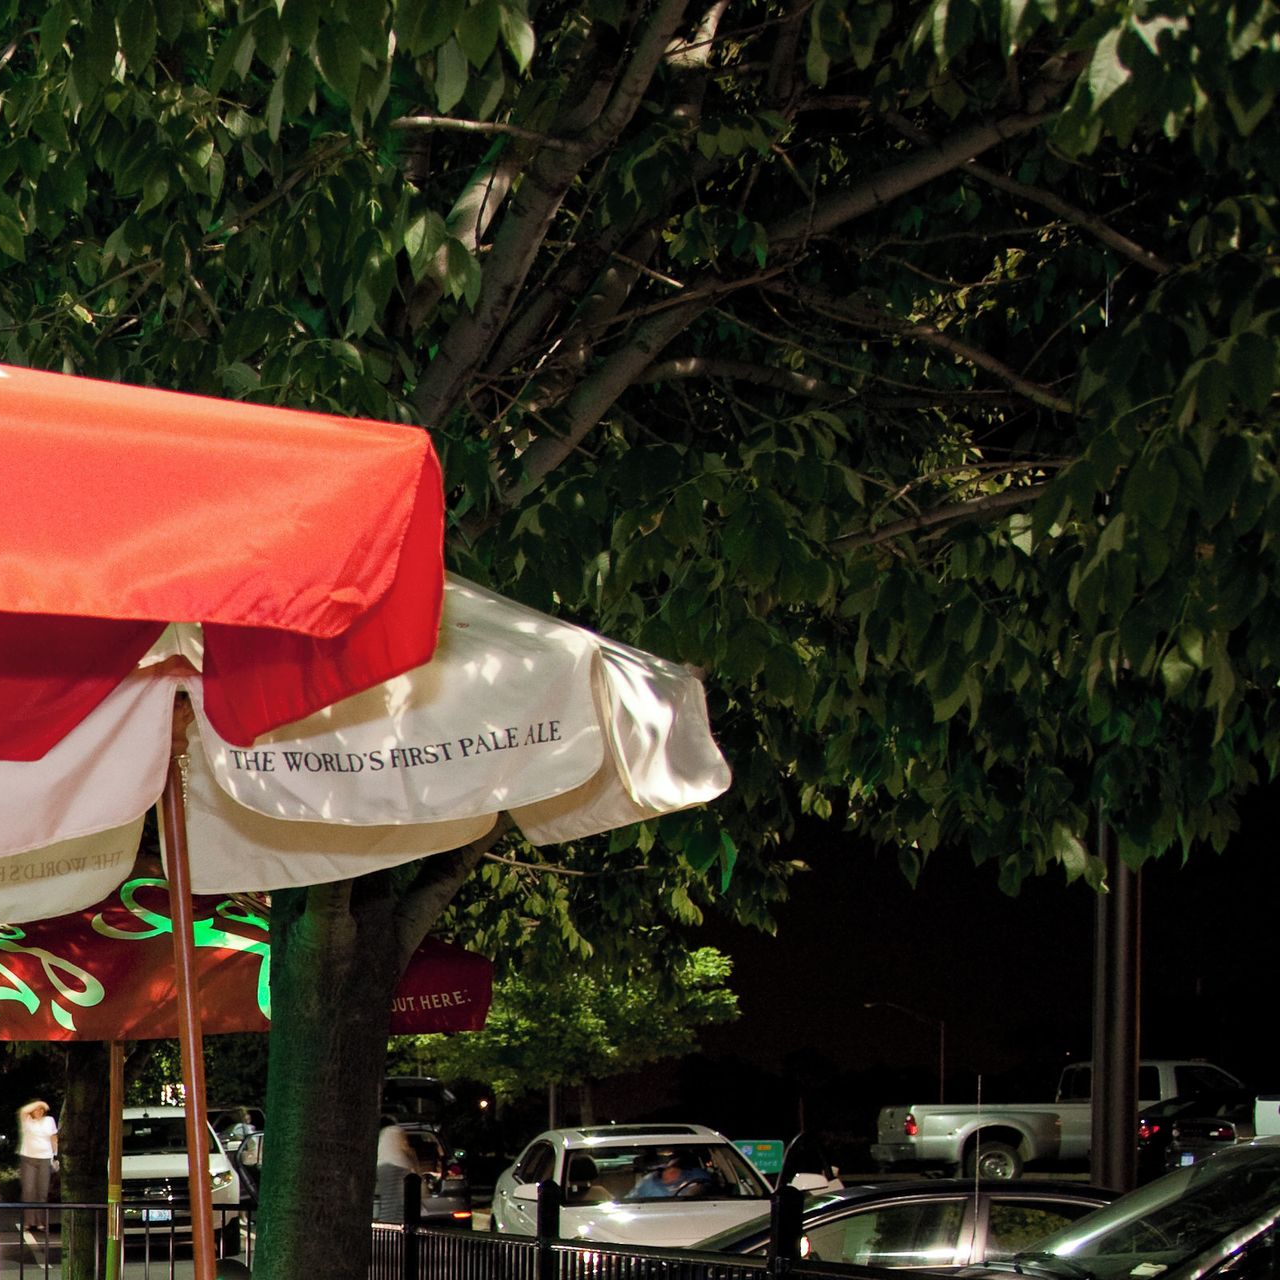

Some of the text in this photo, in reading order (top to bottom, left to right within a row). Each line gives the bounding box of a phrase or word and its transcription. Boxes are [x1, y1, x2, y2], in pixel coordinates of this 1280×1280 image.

[230, 720, 562, 773] THE WORLD'S FIRST PALE ALE
